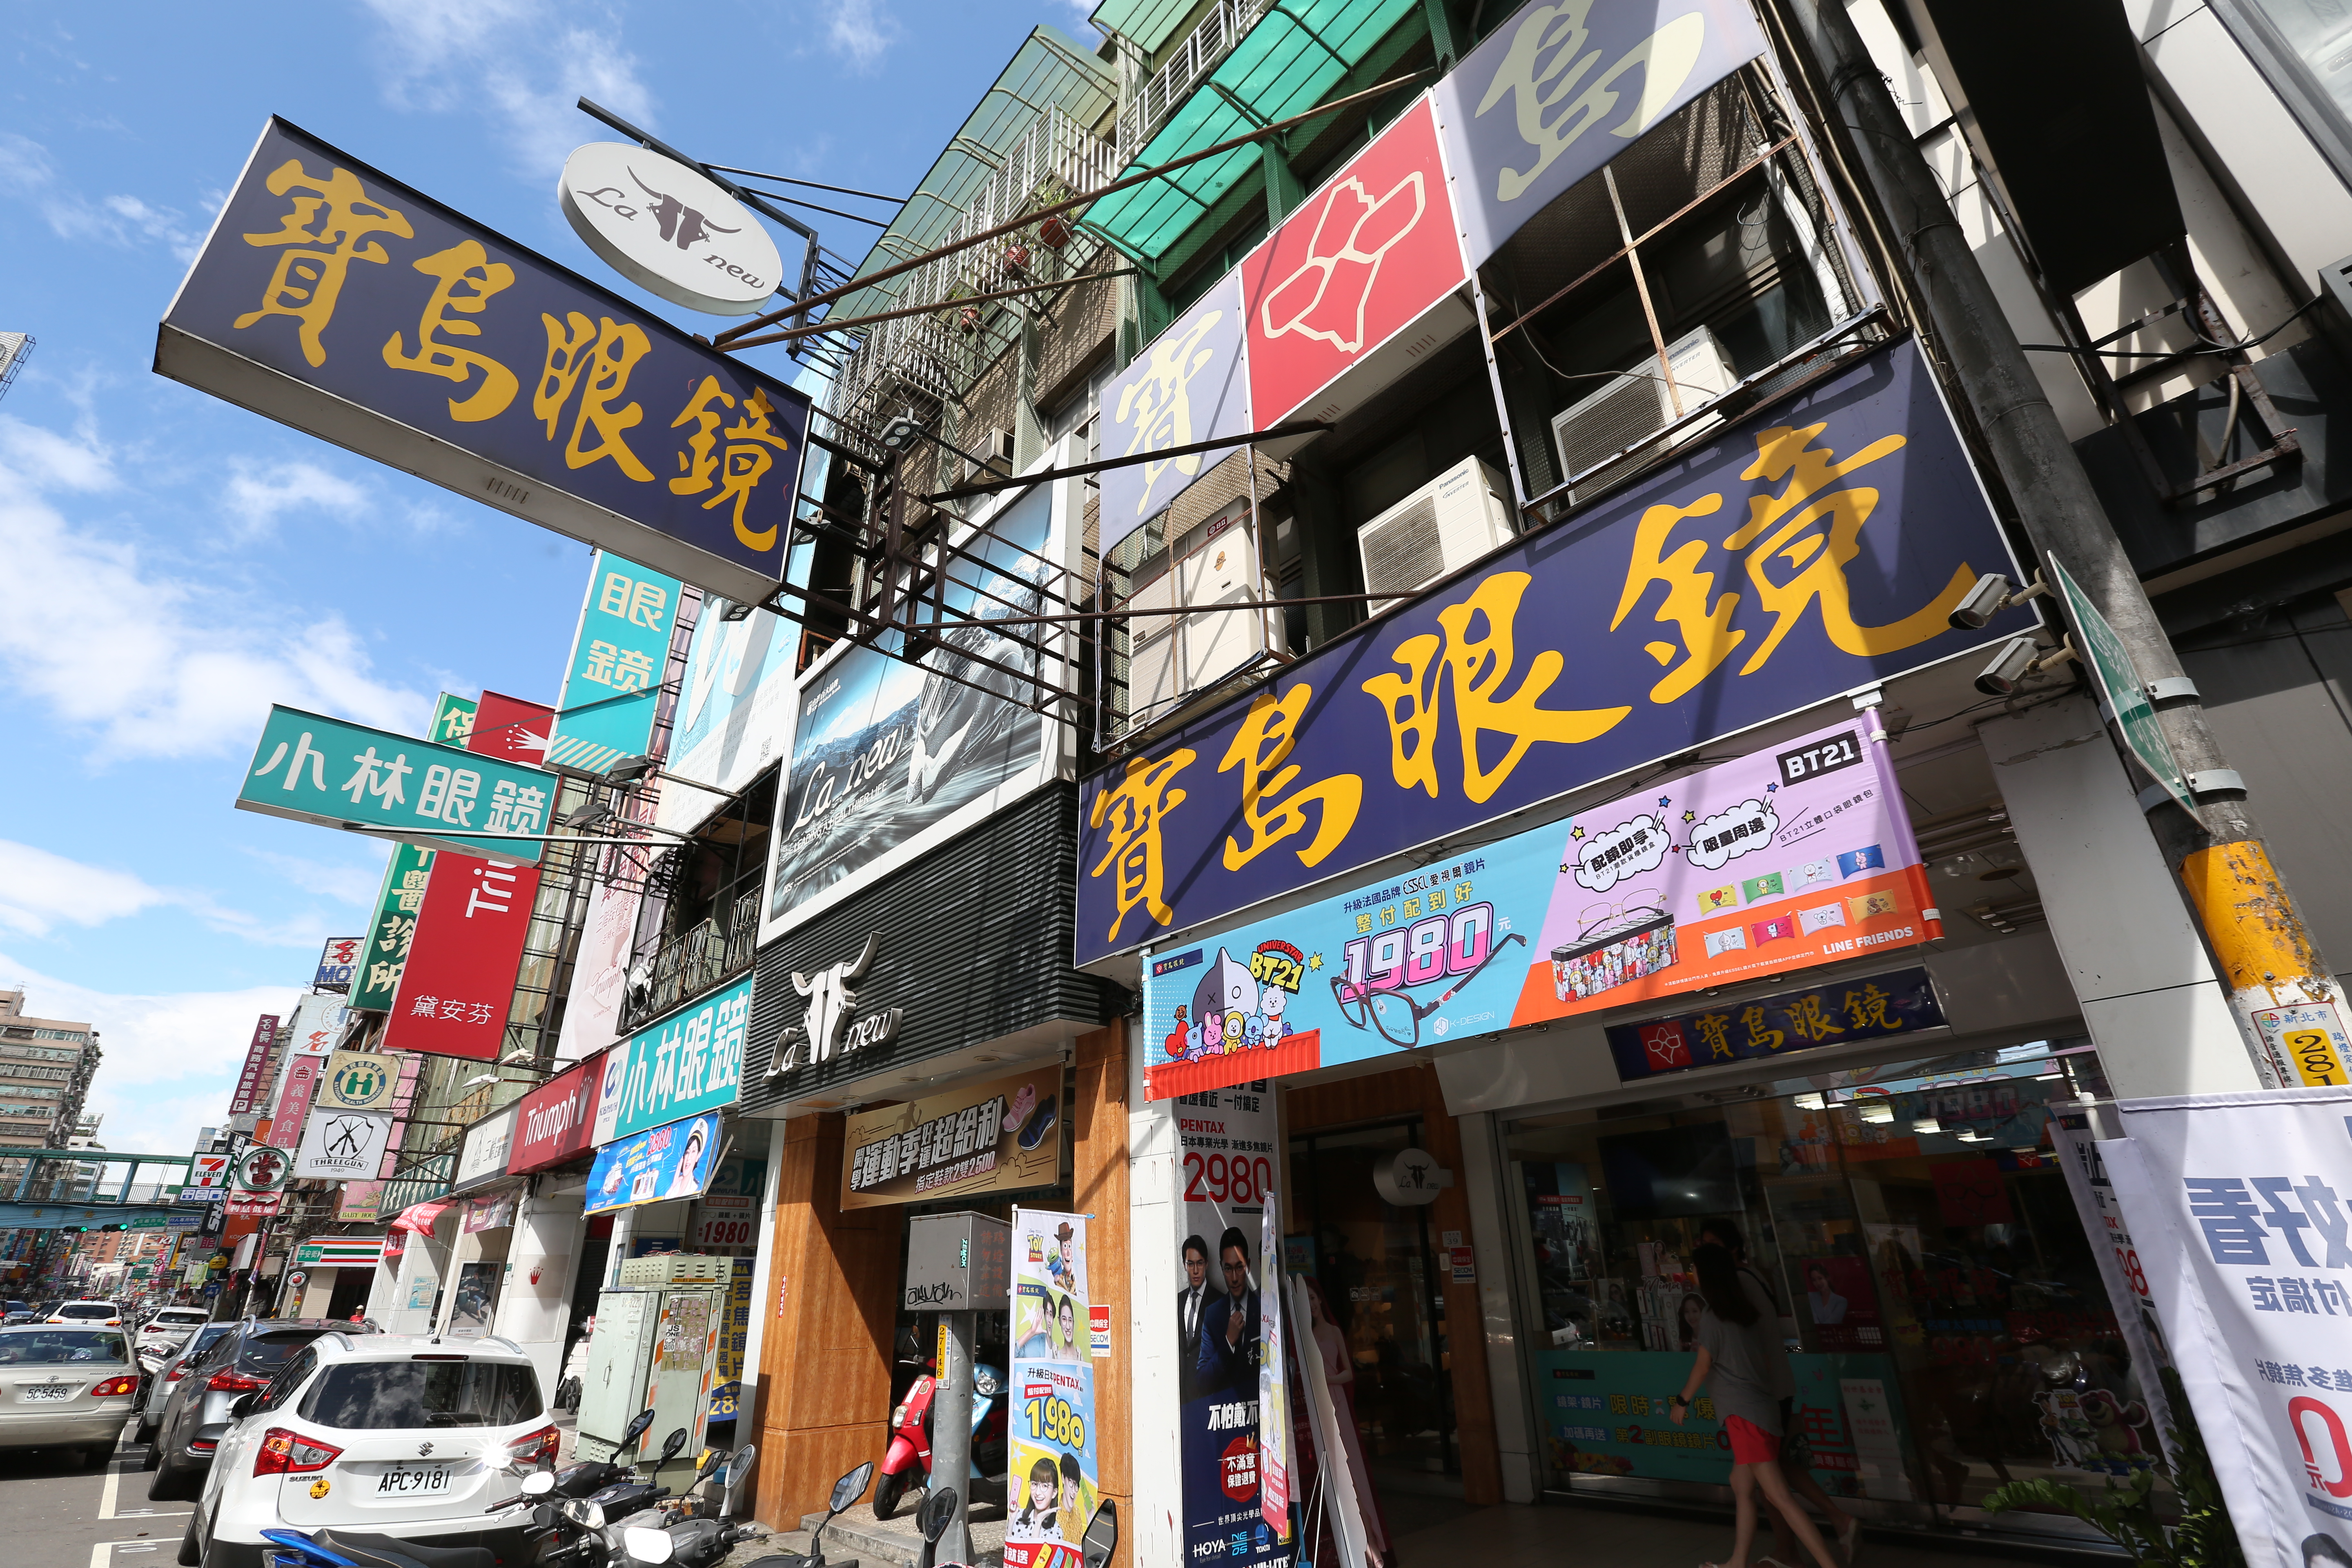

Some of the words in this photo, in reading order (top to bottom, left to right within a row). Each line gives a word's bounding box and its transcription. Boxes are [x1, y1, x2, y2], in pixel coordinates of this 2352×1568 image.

[576, 187, 638, 221] La
[702, 254, 765, 289] new
[233, 158, 789, 552] 寶島眼鏡
[1668, 338, 1700, 360] anasonic
[1439, 468, 1469, 490] Panasonic
[1443, 481, 1469, 499] INVERTER
[1216, 518, 1226, 530] 日立
[581, 572, 667, 698] 眼鏡
[1089, 422, 1978, 943] 寶島眼鏡
[1785, 739, 1855, 779] BT21
[255, 731, 546, 835] 小林眼鏡
[788, 761, 835, 840] La
[842, 724, 904, 795] new
[794, 829, 822, 853] LEADING
[829, 793, 869, 828] HEALTHIER
[870, 782, 887, 800] LIFE
[1779, 789, 1873, 843] BT21立體口袋眼鏡包
[1590, 828, 1649, 872] 配鏡即享
[1702, 817, 1766, 854] 限量周邊
[1343, 886, 1401, 914] 升級法國品牌
[1430, 865, 1462, 886] 愛視爾
[1463, 858, 1486, 875] 鏡片
[1355, 880, 1473, 934] 整付配到好
[1257, 940, 1304, 964] UNIVERSTAR
[1339, 902, 1494, 1005] 1980
[1497, 916, 1513, 933] 元
[1822, 940, 1854, 956] LINE
[1856, 926, 1914, 948] FRIENDS
[316, 965, 356, 982] MO
[591, 956, 624, 999] Triumph
[1249, 951, 1305, 995] BT21
[410, 994, 494, 1025] 黛安芬
[1449, 1010, 1495, 1029] K-DESIGN
[1695, 983, 1903, 1059] 寶島眼鏡
[2283, 1009, 2328, 1023] 新北市
[619, 990, 749, 1124] 小林眼鏡
[761, 1027, 807, 1085] La
[842, 1007, 903, 1054] new
[238, 1045, 266, 1099] 商務汽車旅館
[236, 1101, 246, 1110] P
[334, 1081, 344, 1102] NATIONAL
[363, 1084, 384, 1104] INSURANCE
[1224, 1094, 1260, 1113] 一付搞定
[273, 1083, 305, 1148] 義美食品
[524, 1089, 577, 1147] Triumph
[1180, 1118, 1225, 1134] PENTAX
[646, 1126, 671, 1157] 2880
[850, 1147, 865, 1191] 開學
[860, 1126, 923, 1188] 運動季
[918, 1124, 934, 1169] 好運
[930, 1094, 1004, 1163] 超給利
[1180, 1135, 1229, 1149] 日本專業光學
[1231, 1139, 1273, 1154] 漸進多焦鏡片
[249, 1152, 281, 1185] 當
[314, 1159, 365, 1169] THREEGUN
[915, 1151, 997, 1195] 指定鞋款2雙2,500元
[1183, 1152, 1273, 1205] 2980
[1399, 1175, 1411, 1188] La
[1426, 1182, 1440, 1190] new
[229, 1204, 274, 1214] 利息低廉
[199, 1236, 216, 1250] 館
[703, 1221, 750, 1244] 1980
[1027, 1234, 1044, 1252] TOY
[298, 1249, 317, 1258] 平安街
[731, 1280, 751, 1377] 多焦鏡片
[1089, 1319, 1108, 1329] 中興保全
[1090, 1334, 1108, 1343] SECOM
[937, 1327, 945, 1376] 27146
[1930, 1336, 1997, 1366] 980
[1557, 1395, 1601, 1410] 鏡架·鏡片
[1609, 1394, 1650, 1417] 限時
[1025, 1395, 1085, 1450] 1980
[1564, 1425, 1606, 1441] 加碼再送
[1226, 1452, 1256, 1472] 不滿意
[1227, 1471, 1256, 1489] 保證退費
[1192, 1538, 1226, 1558] HOYA
[1255, 1544, 1271, 1554] TOKAI
[1278, 1537, 1292, 1546] Nikon
